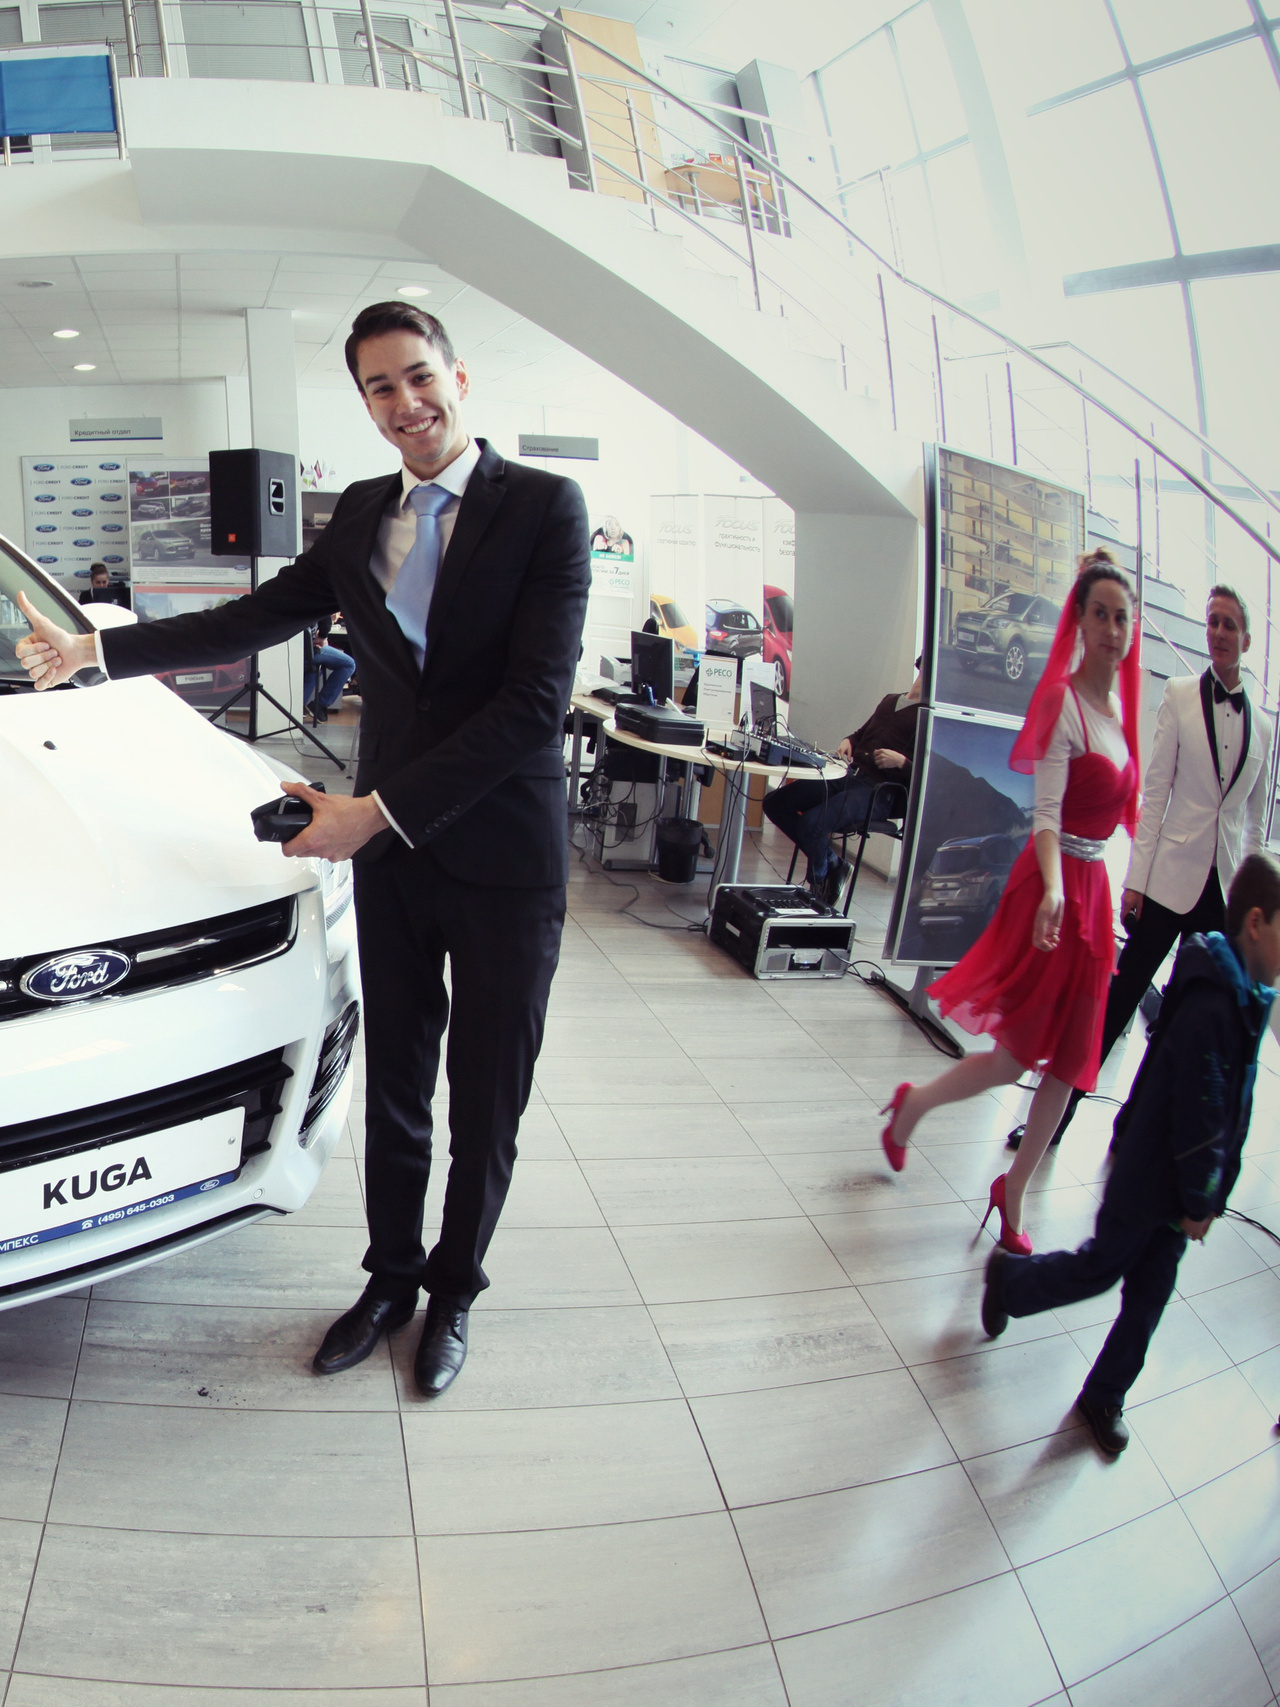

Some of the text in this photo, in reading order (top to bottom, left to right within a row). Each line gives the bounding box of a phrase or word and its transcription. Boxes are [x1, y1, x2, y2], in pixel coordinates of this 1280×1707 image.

[74, 428, 131, 437] Кредитный отдел
[521, 444, 560, 453] Страхование
[614, 566, 619, 575] 7
[713, 668, 733, 678] РЕСО
[43, 955, 110, 993] Ford
[43, 1156, 153, 1210] KUGA
[97, 1194, 175, 1225] (495) 645-0303
